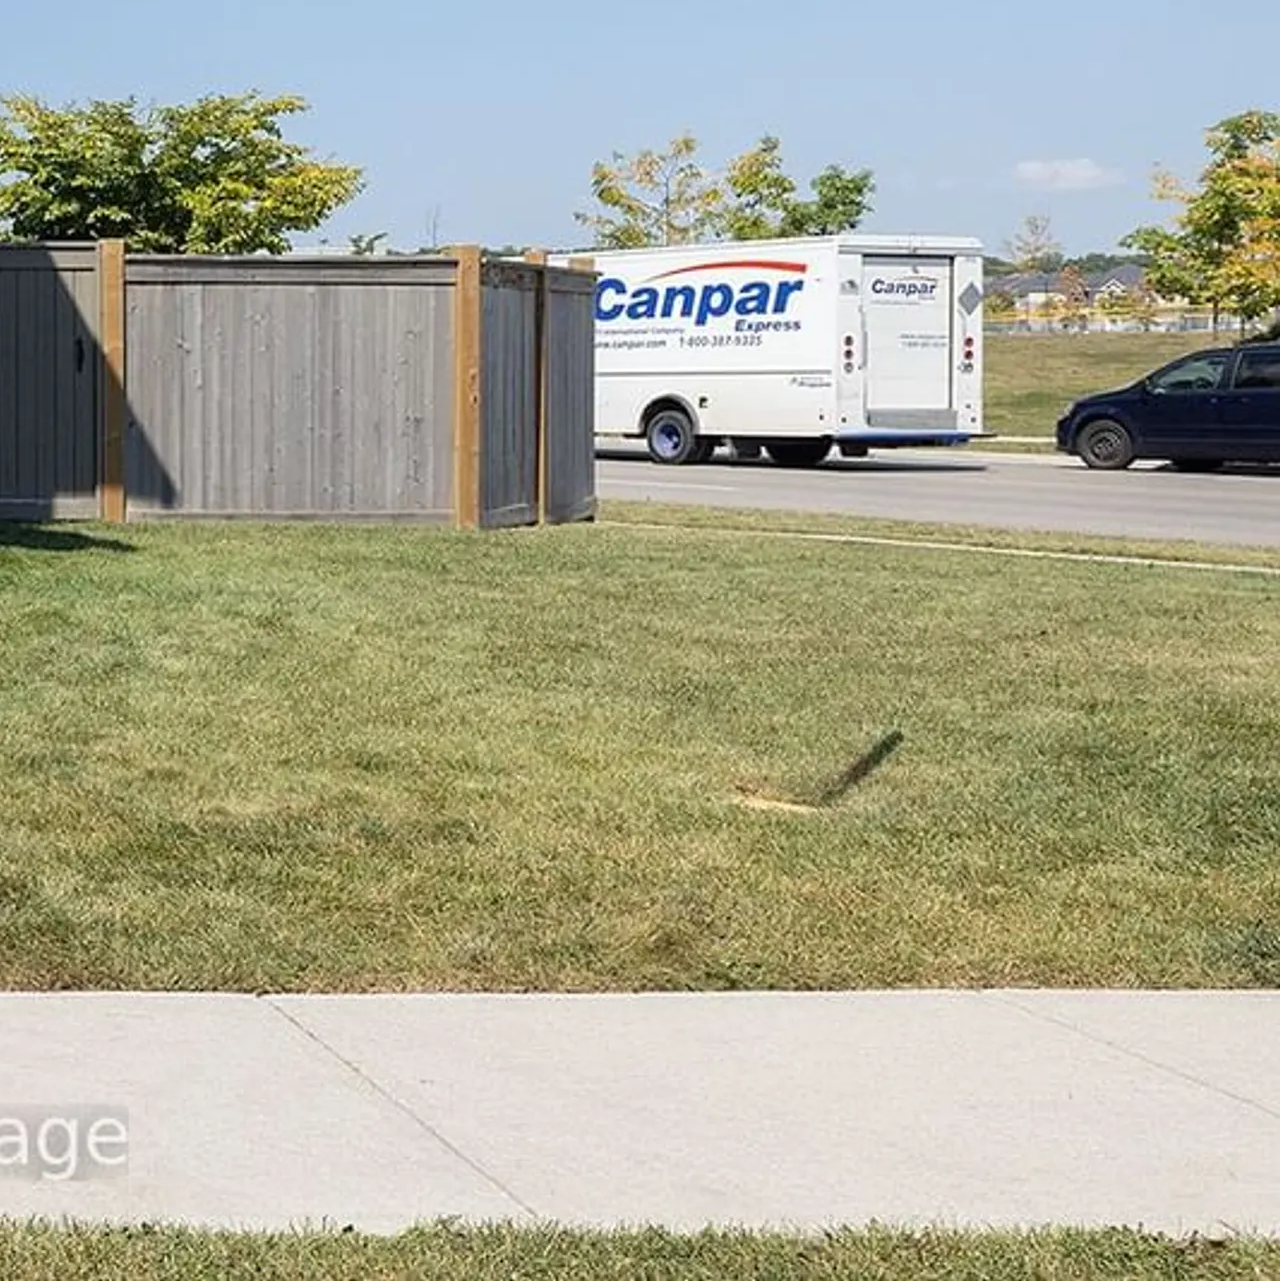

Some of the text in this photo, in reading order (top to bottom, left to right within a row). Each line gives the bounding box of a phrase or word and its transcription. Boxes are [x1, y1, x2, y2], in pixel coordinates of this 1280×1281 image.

[871, 278, 937, 297] Canpar
[595, 277, 805, 326] Canpar
[734, 319, 802, 334] Express
